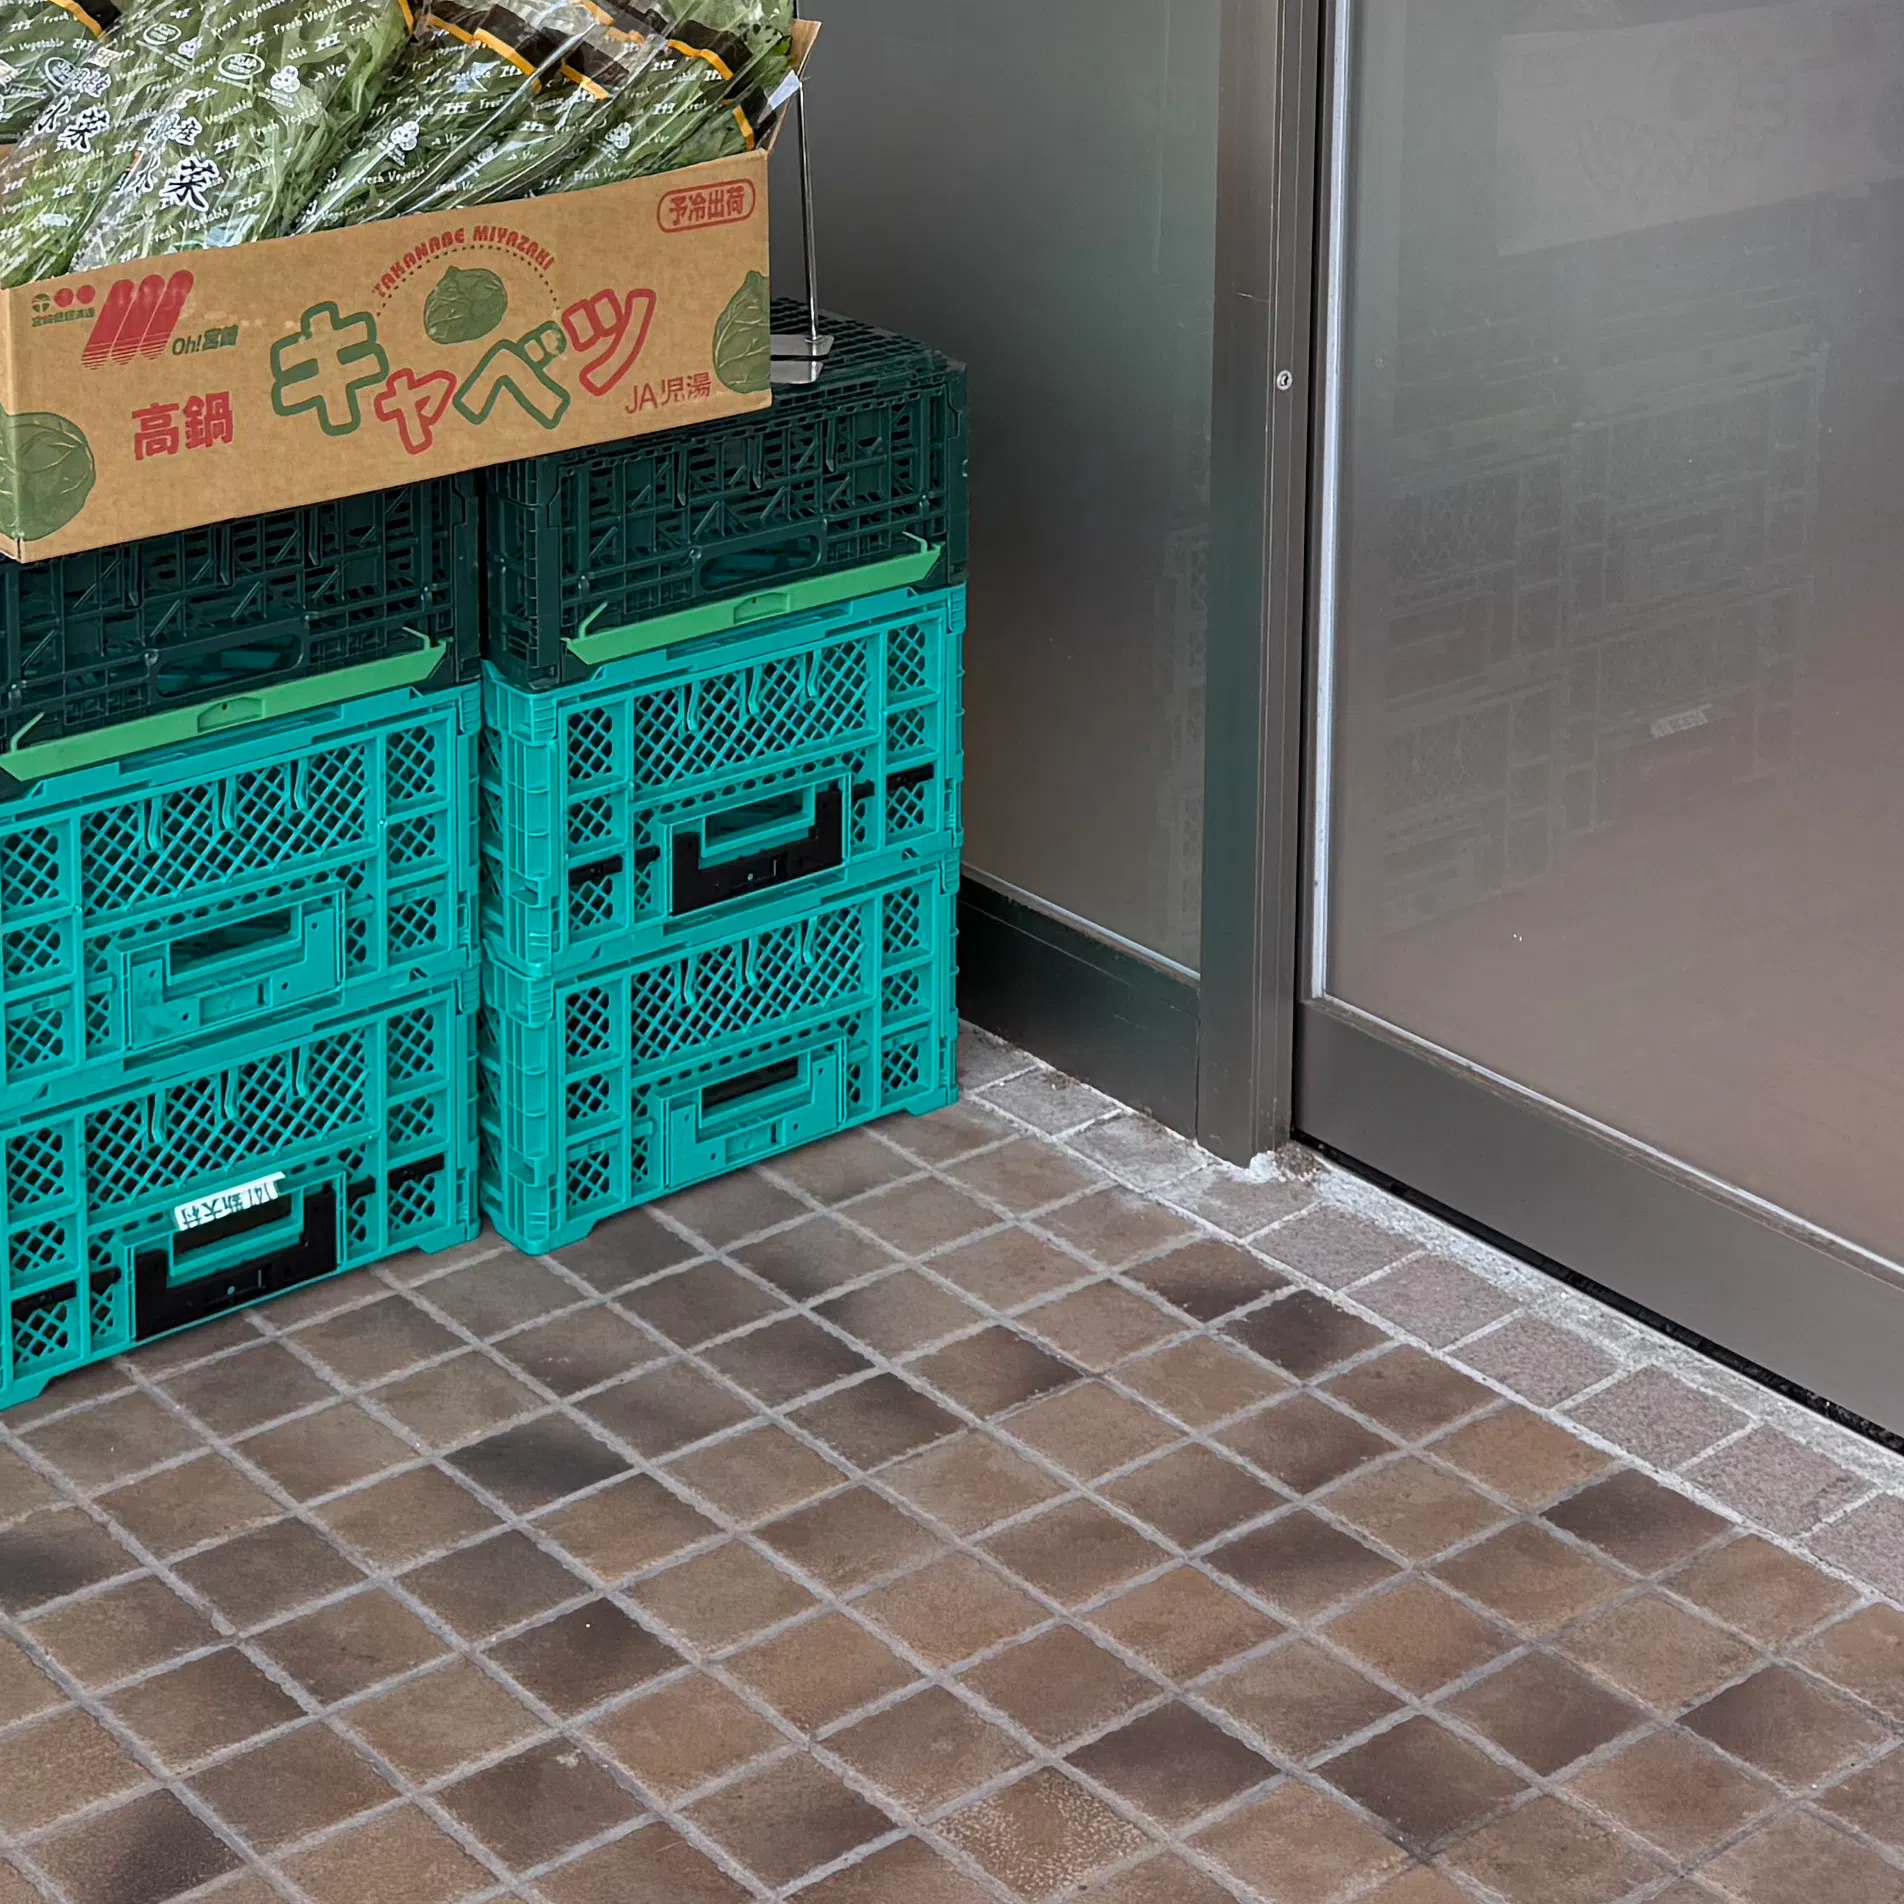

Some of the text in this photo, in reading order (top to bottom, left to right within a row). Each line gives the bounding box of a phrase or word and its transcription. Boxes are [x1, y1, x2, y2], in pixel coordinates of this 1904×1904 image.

[273, 16, 302, 34] Fresh
[669, 185, 745, 226] 予冷出荷
[372, 225, 555, 297] TAKANABE MIYAZAKI
[270, 288, 657, 455] キャベツ
[625, 372, 712, 414] JA児湯
[131, 390, 234, 461] 高鍋
